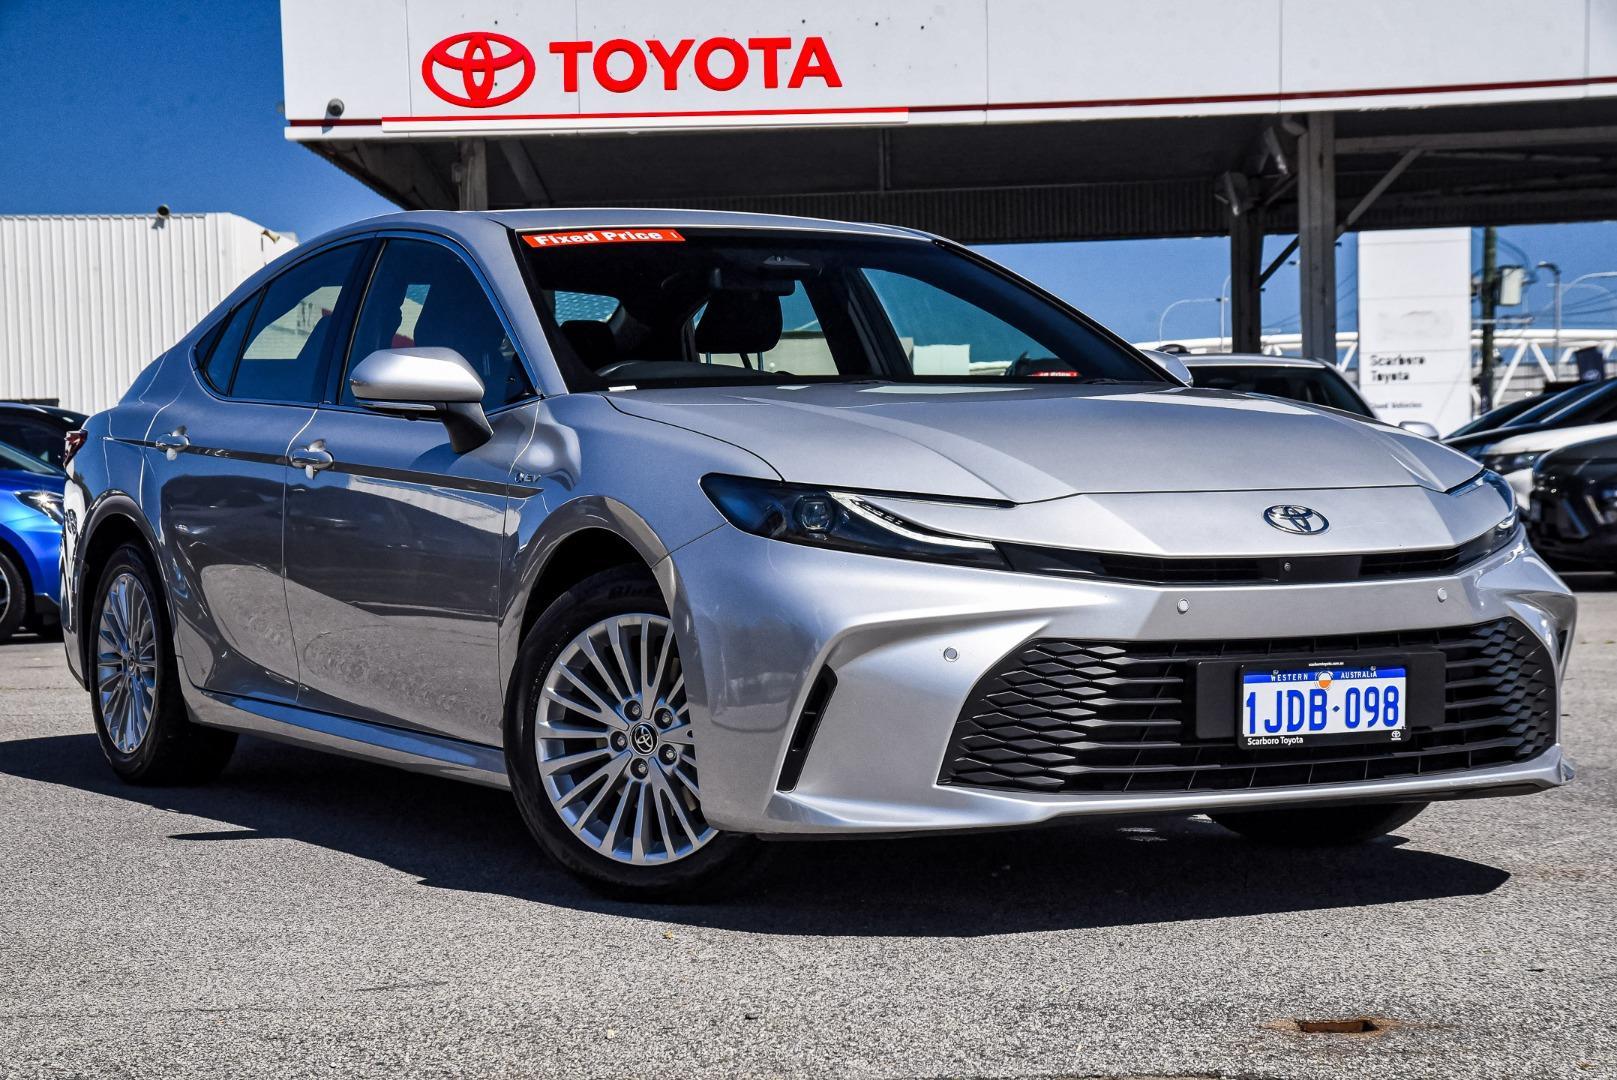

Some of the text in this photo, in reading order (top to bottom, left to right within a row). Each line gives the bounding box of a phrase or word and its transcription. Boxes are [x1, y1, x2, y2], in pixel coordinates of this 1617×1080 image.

[549, 37, 842, 93] TOYOTA
[533, 231, 663, 245] Fixed Price
[1271, 670, 1378, 682] WESTERN AUSTRALIA
[1247, 736, 1304, 746] Scarboro Toyota
